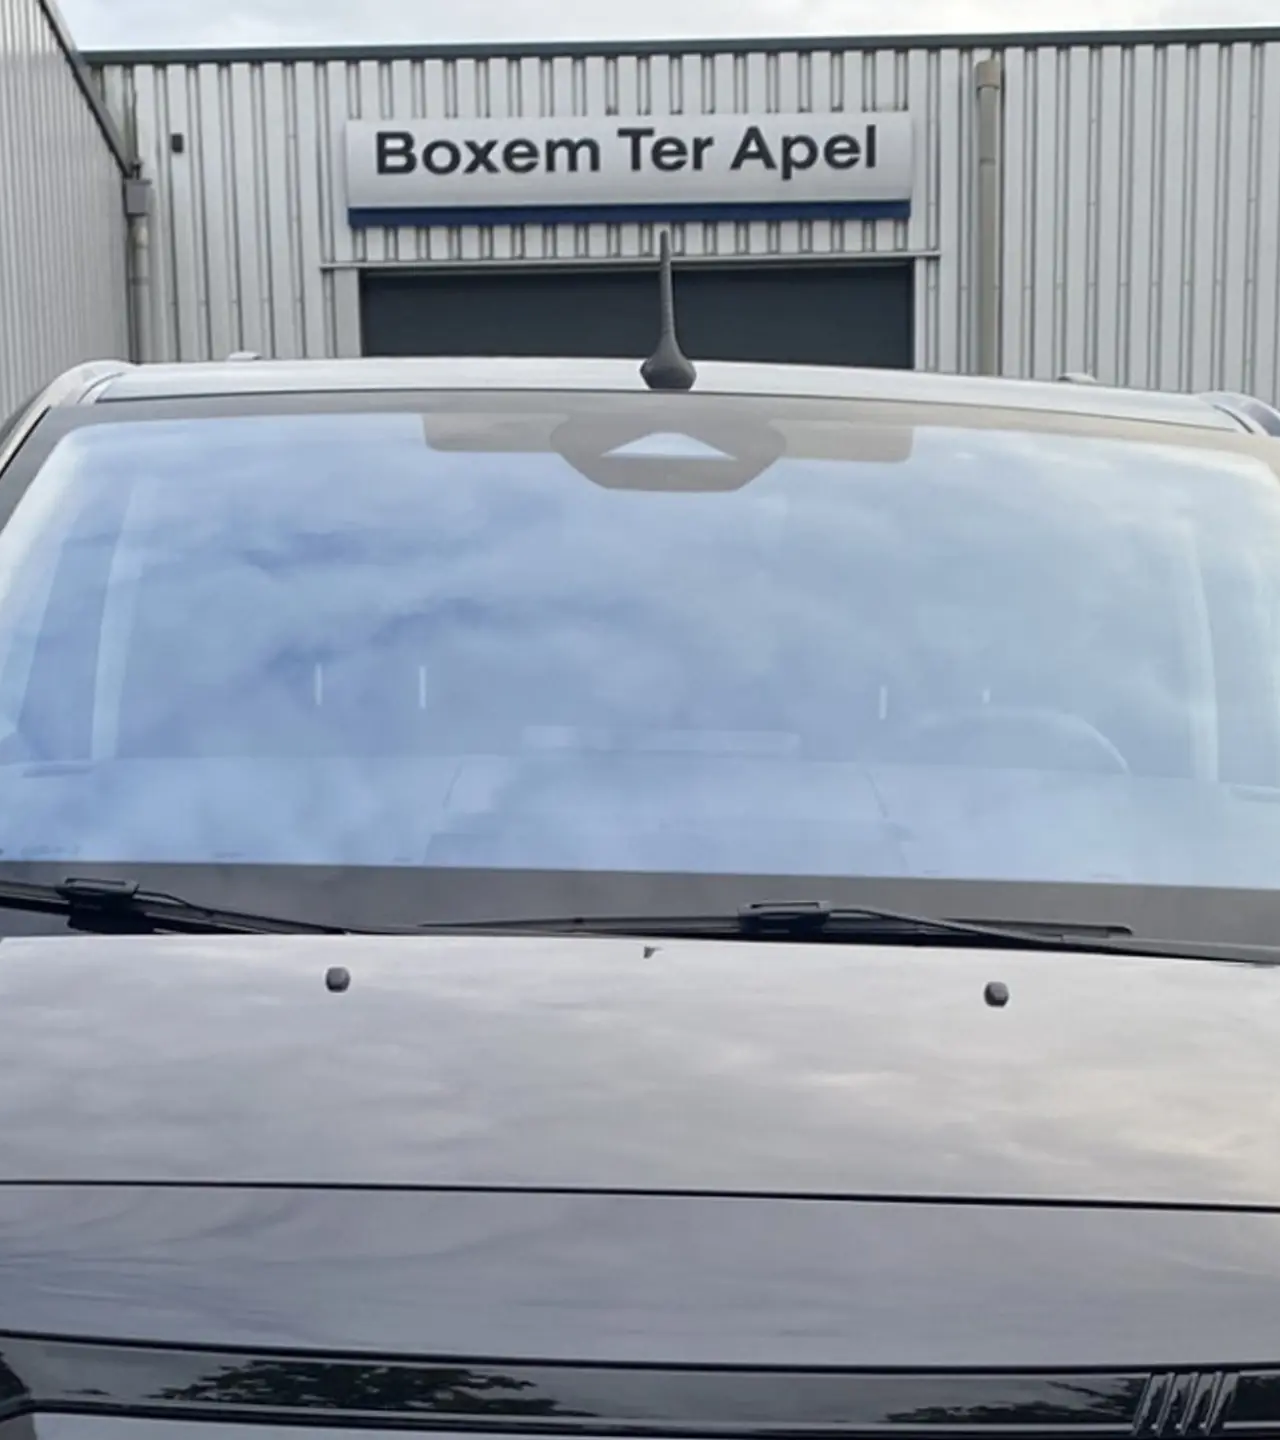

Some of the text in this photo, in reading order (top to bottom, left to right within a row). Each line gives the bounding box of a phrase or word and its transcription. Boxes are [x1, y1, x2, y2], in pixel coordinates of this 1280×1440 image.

[375, 125, 877, 180] Boxem Ter Apel
